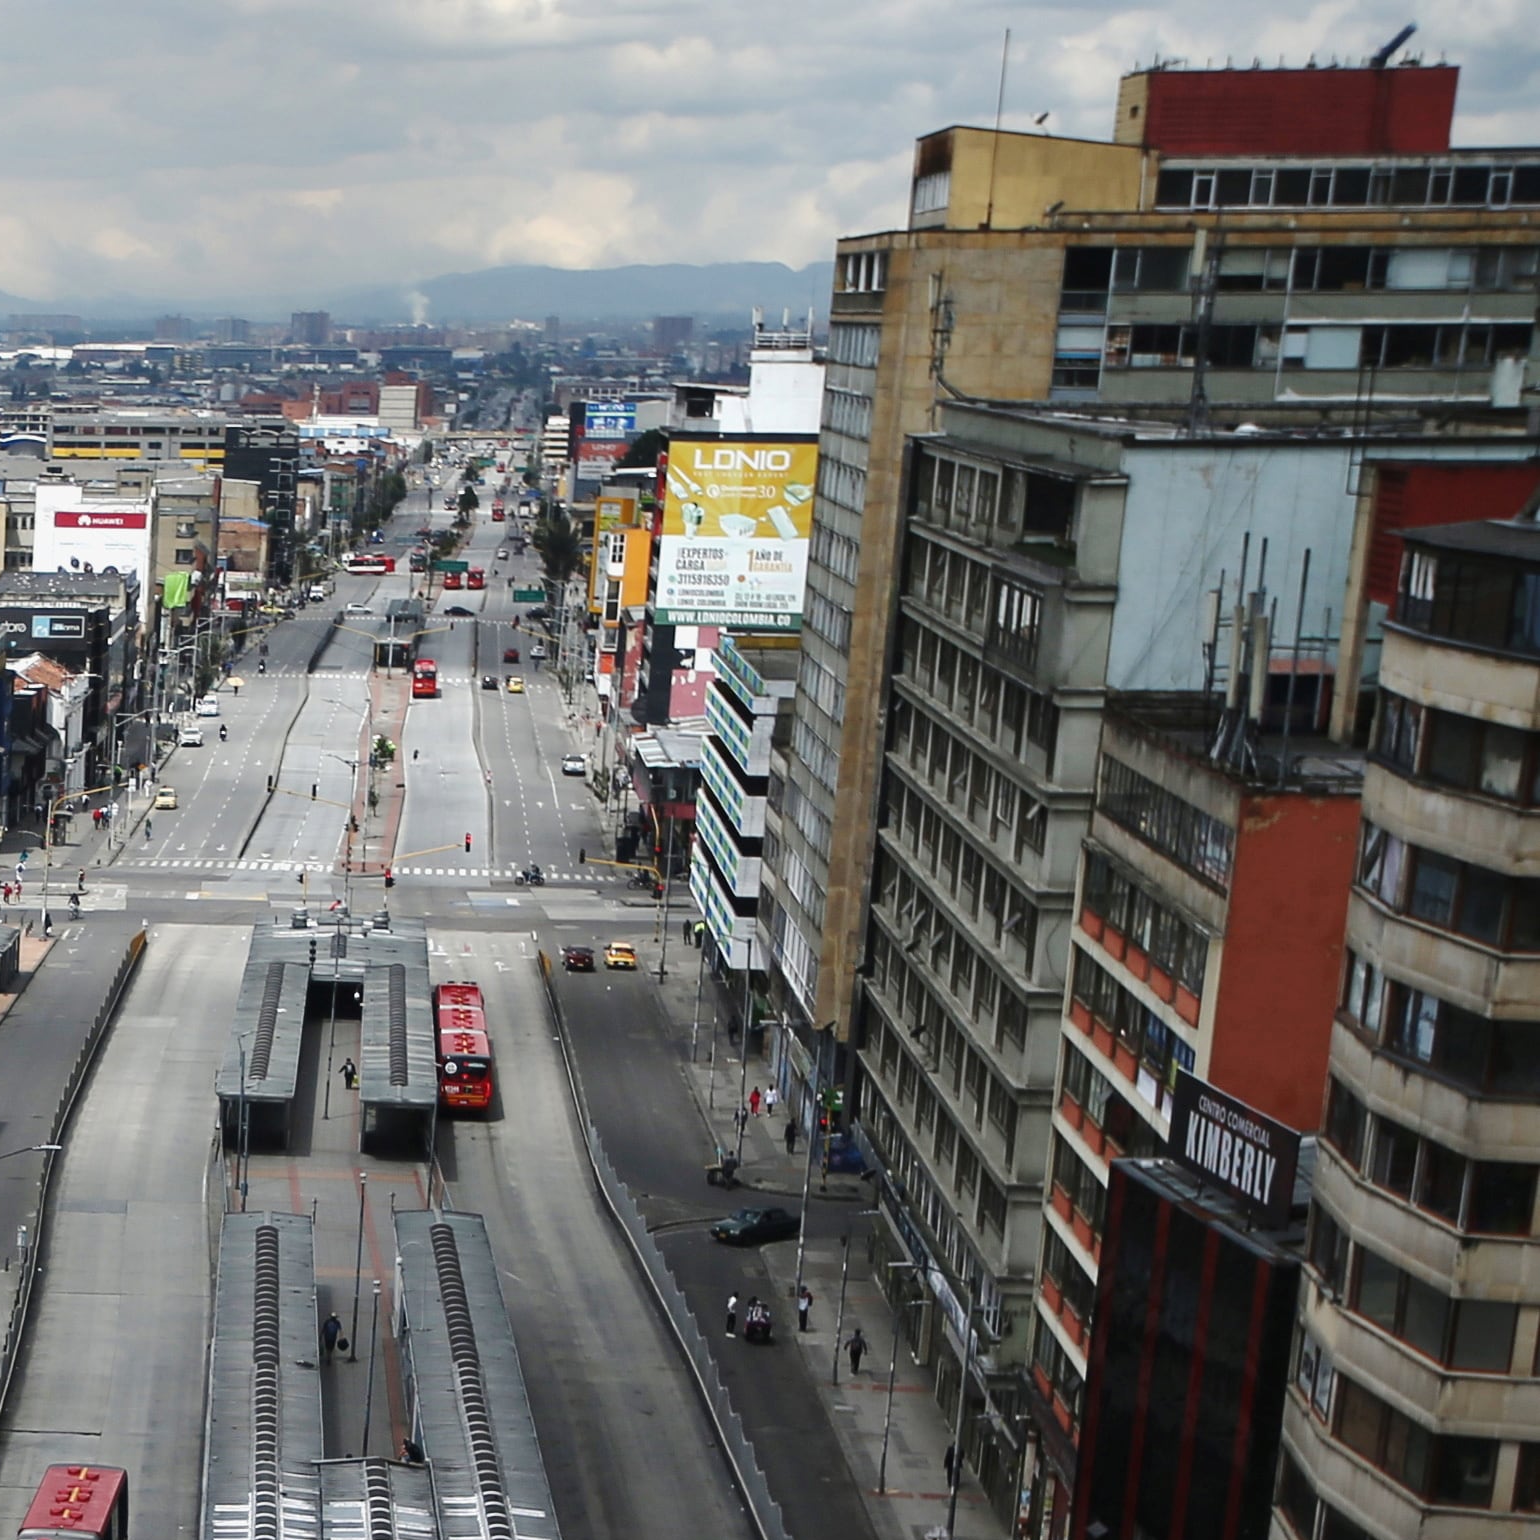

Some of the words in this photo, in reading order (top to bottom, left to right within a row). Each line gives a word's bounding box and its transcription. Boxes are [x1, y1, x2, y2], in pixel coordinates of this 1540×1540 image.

[694, 449, 791, 471] LDNIO
[92, 518, 124, 526] HUAWEI
[681, 549, 724, 560] EXPERTOS
[676, 560, 705, 571] CARGA
[667, 611, 791, 627] WWW.LDNIOCOLOMBIA.CO
[1198, 1095, 1226, 1123] CENTRO
[1227, 1111, 1270, 1149] COMERCIAL
[1185, 1110, 1276, 1205] KIMBERLY
